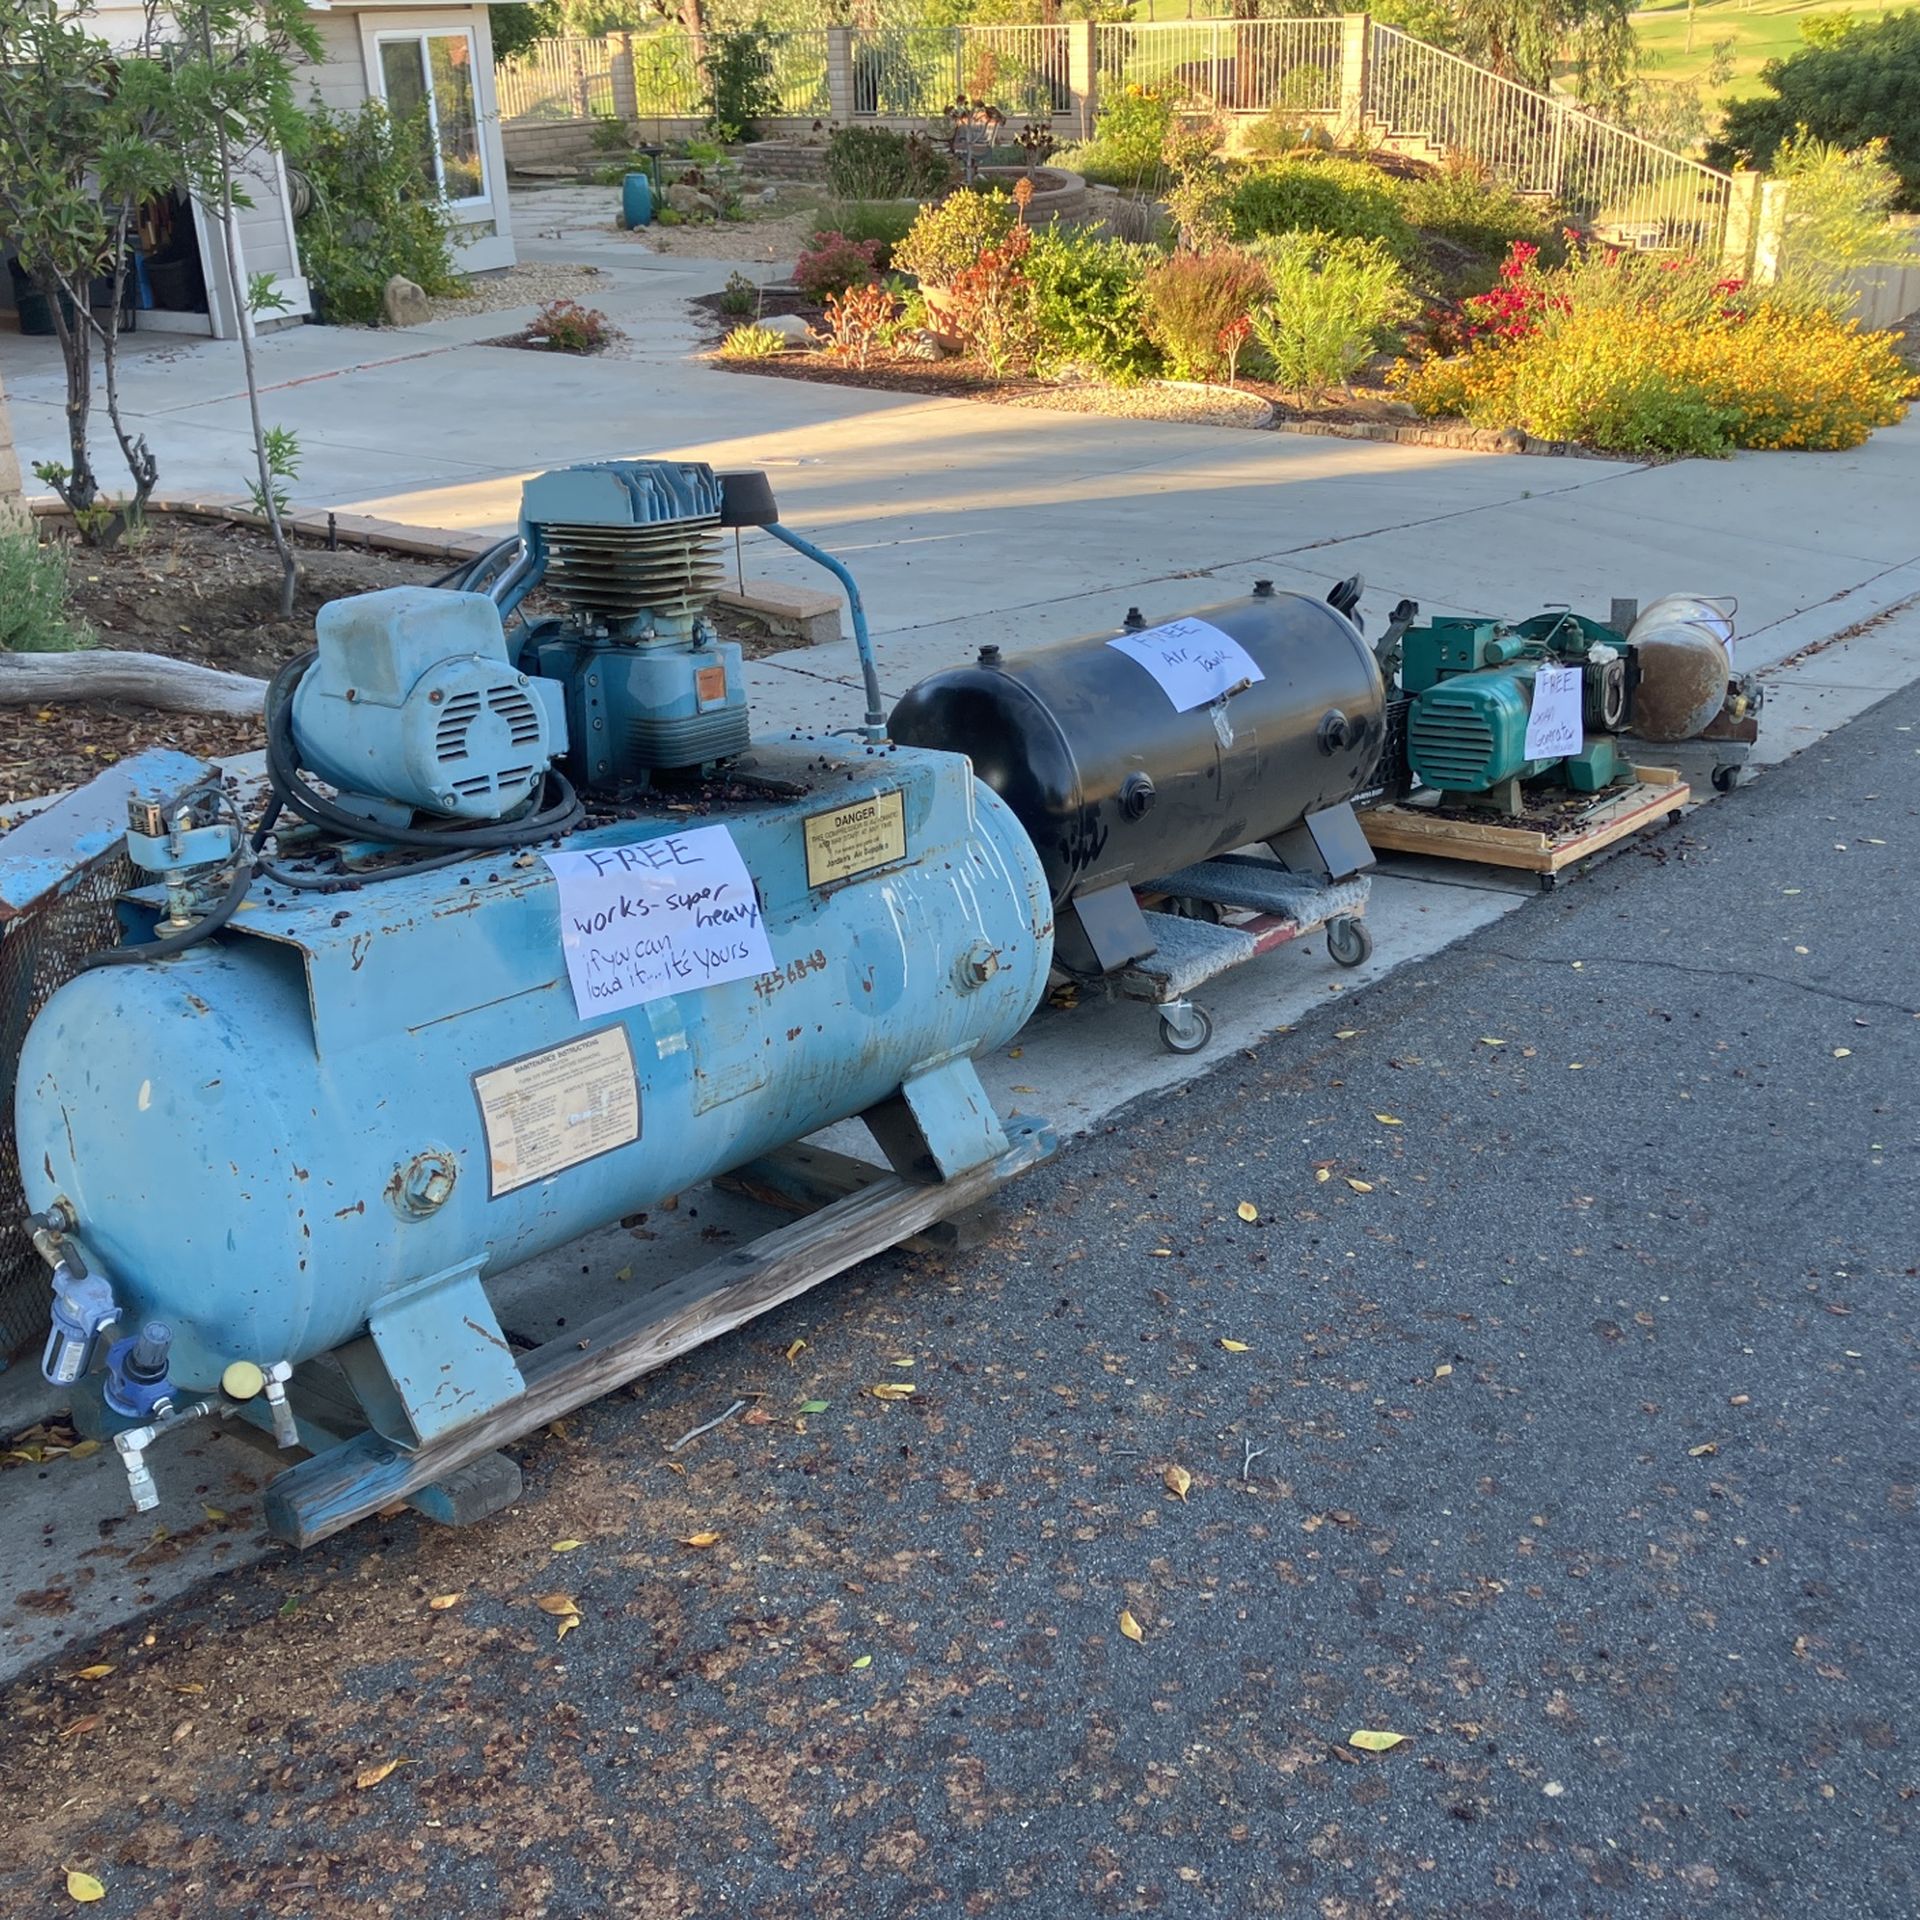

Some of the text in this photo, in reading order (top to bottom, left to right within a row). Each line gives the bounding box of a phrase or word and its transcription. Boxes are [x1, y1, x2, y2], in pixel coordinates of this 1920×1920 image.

[1131, 624, 1201, 648] FREE
[1193, 651, 1232, 672] Tank
[1542, 672, 1573, 694] FREE
[835, 807, 875, 827] DANGER
[586, 839, 704, 877] FREE
[696, 903, 757, 928] heavy
[635, 936, 672, 958] can
[586, 977, 622, 1000] load
[513, 1038, 598, 1073] MAINTENANCE INSTRUCTIONS
